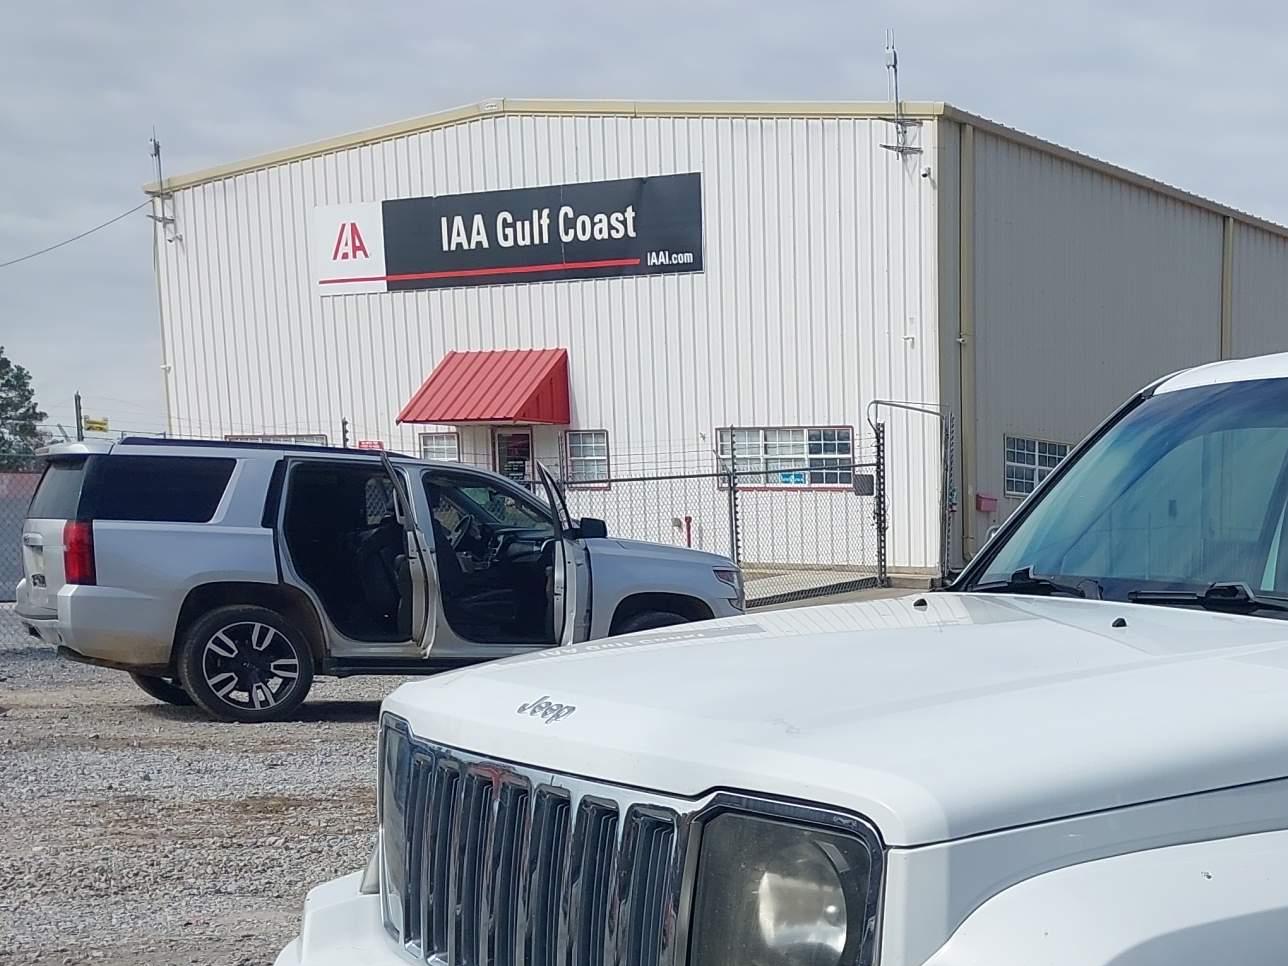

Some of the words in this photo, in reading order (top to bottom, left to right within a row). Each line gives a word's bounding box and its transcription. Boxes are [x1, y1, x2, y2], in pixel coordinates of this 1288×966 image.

[441, 215, 489, 252] IAA
[497, 208, 550, 247] Gulf
[558, 205, 636, 243] Coast
[646, 251, 694, 267] IAAI.com
[517, 695, 576, 725] Jeep
